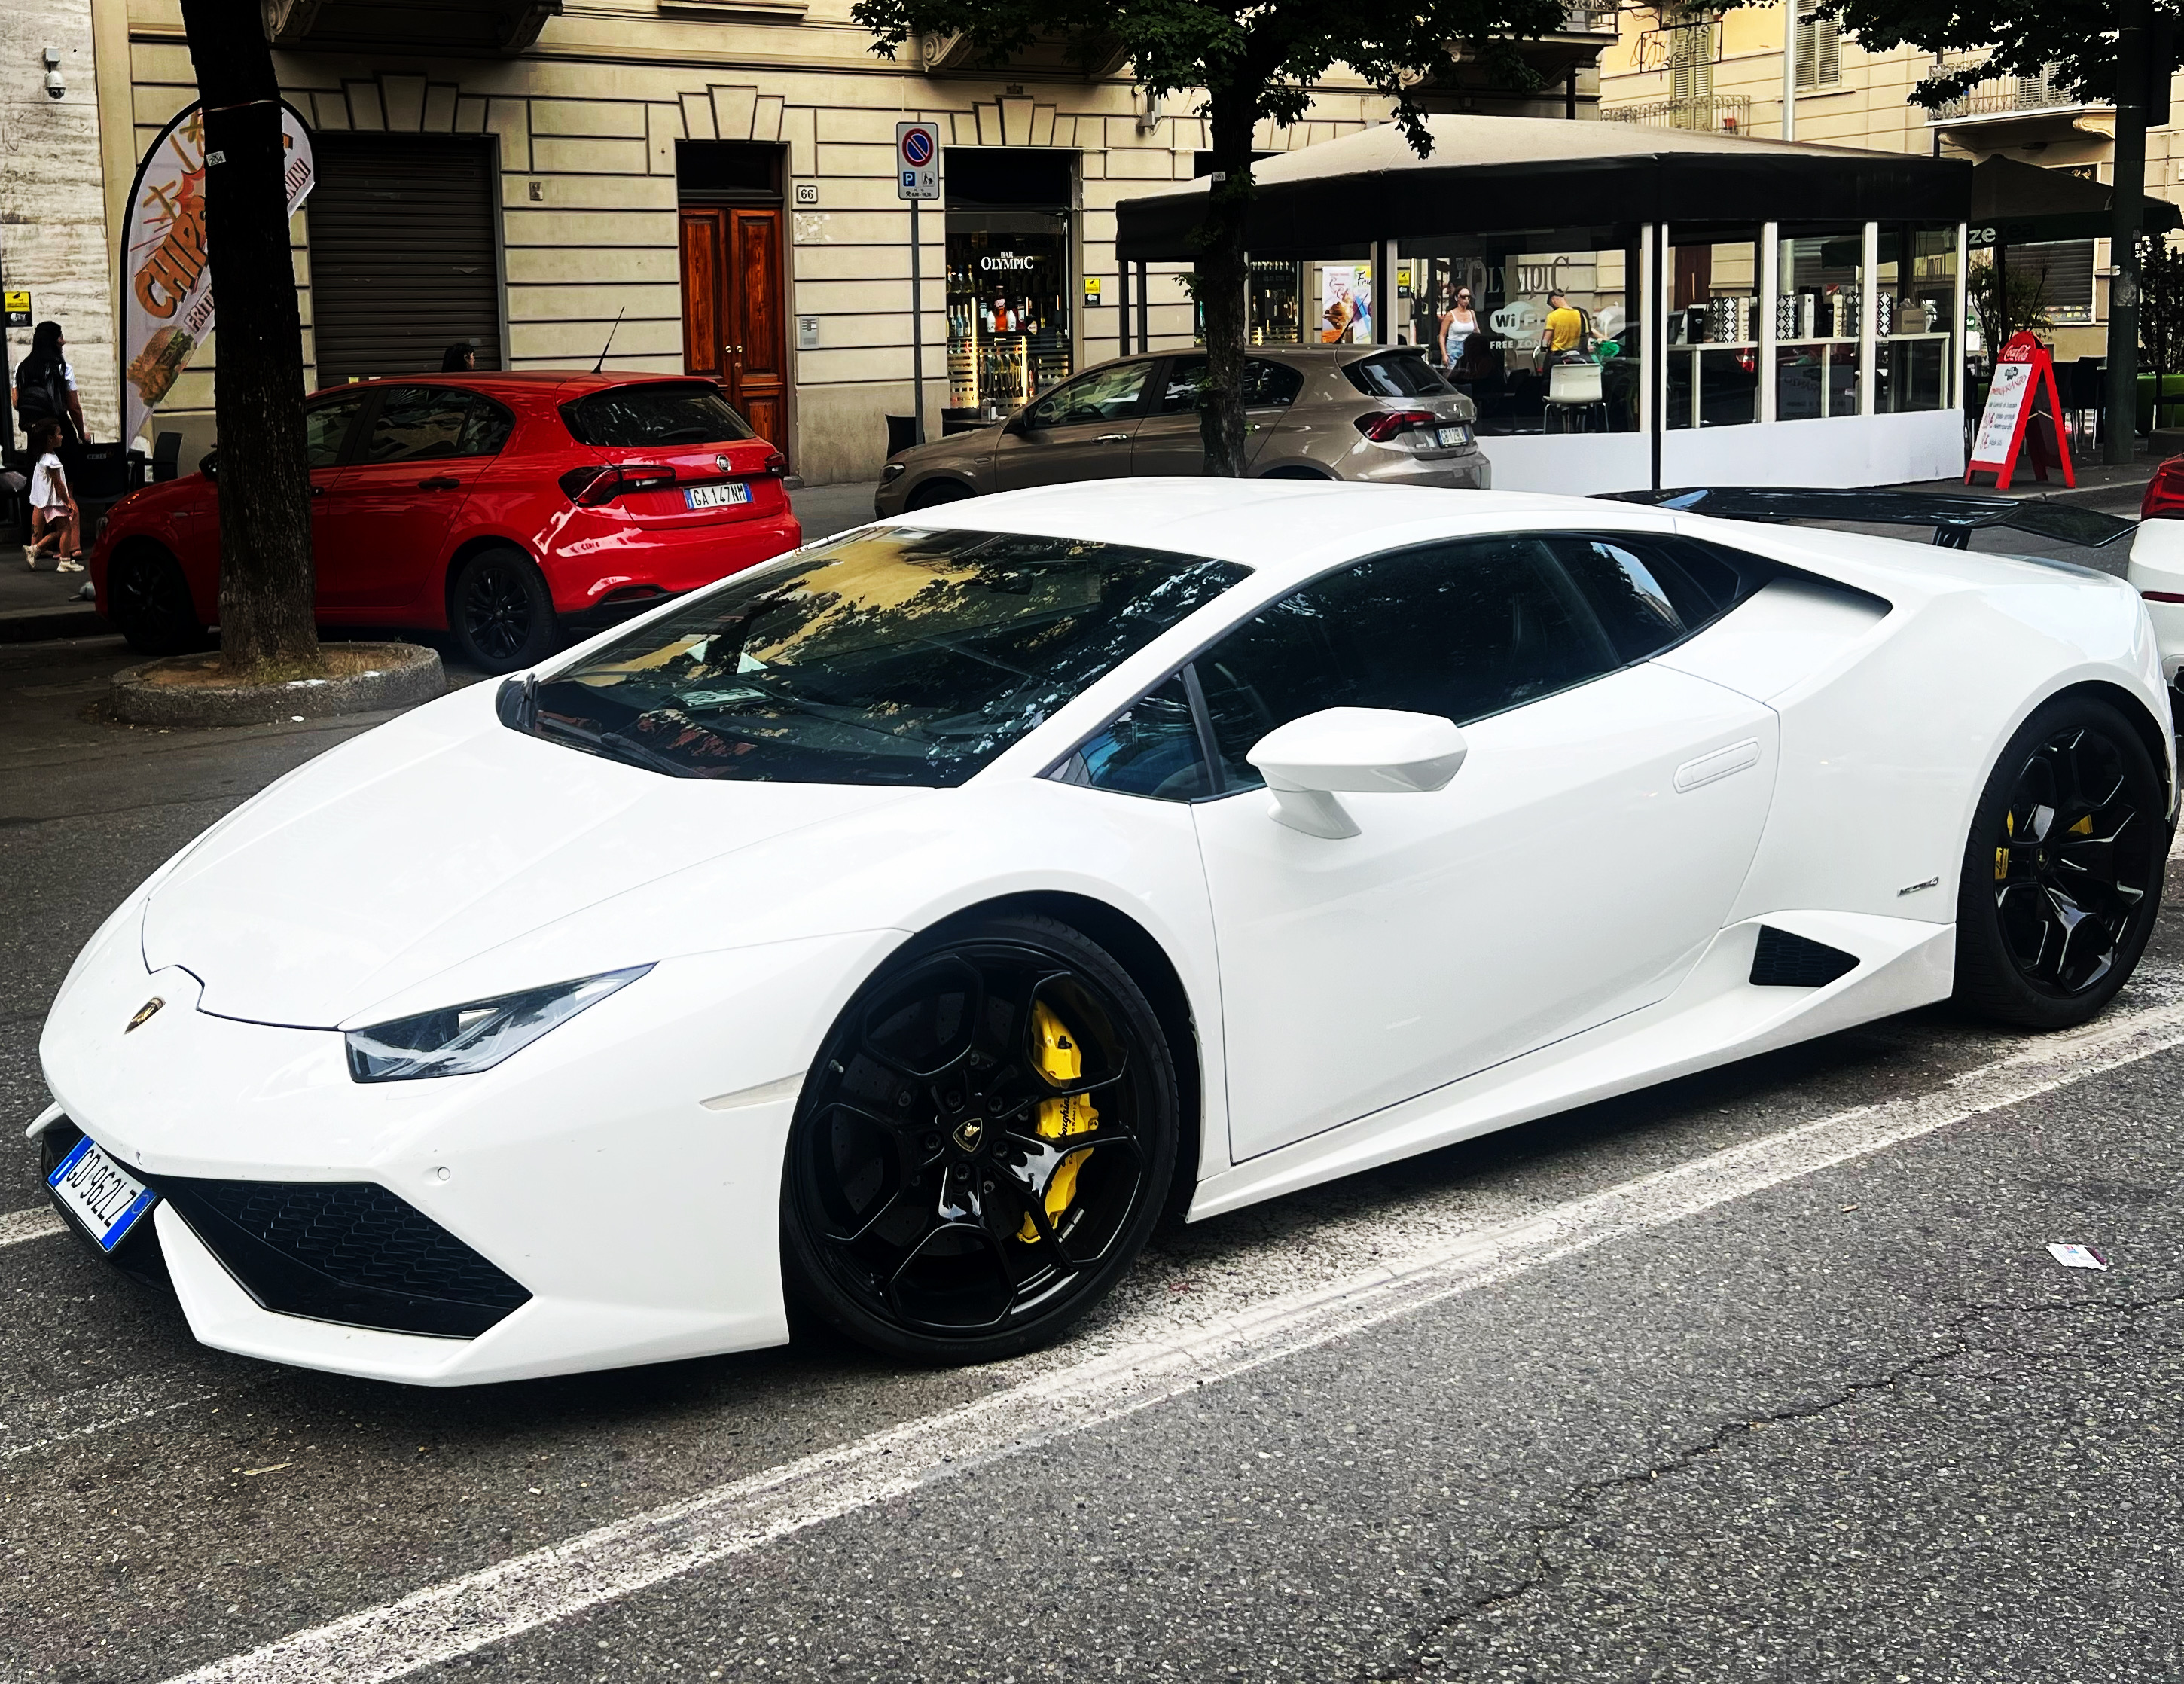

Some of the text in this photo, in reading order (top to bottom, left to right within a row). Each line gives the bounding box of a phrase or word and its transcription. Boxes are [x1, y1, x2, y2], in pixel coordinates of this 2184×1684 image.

[285, 157, 312, 202] NINI
[801, 188, 814, 200] 66
[981, 255, 1034, 270] OLYMPIC
[1490, 339, 1548, 350] FREE ZONE
[693, 484, 746, 506] GA 147NM
[66, 1149, 139, 1228] GD 962LZ
